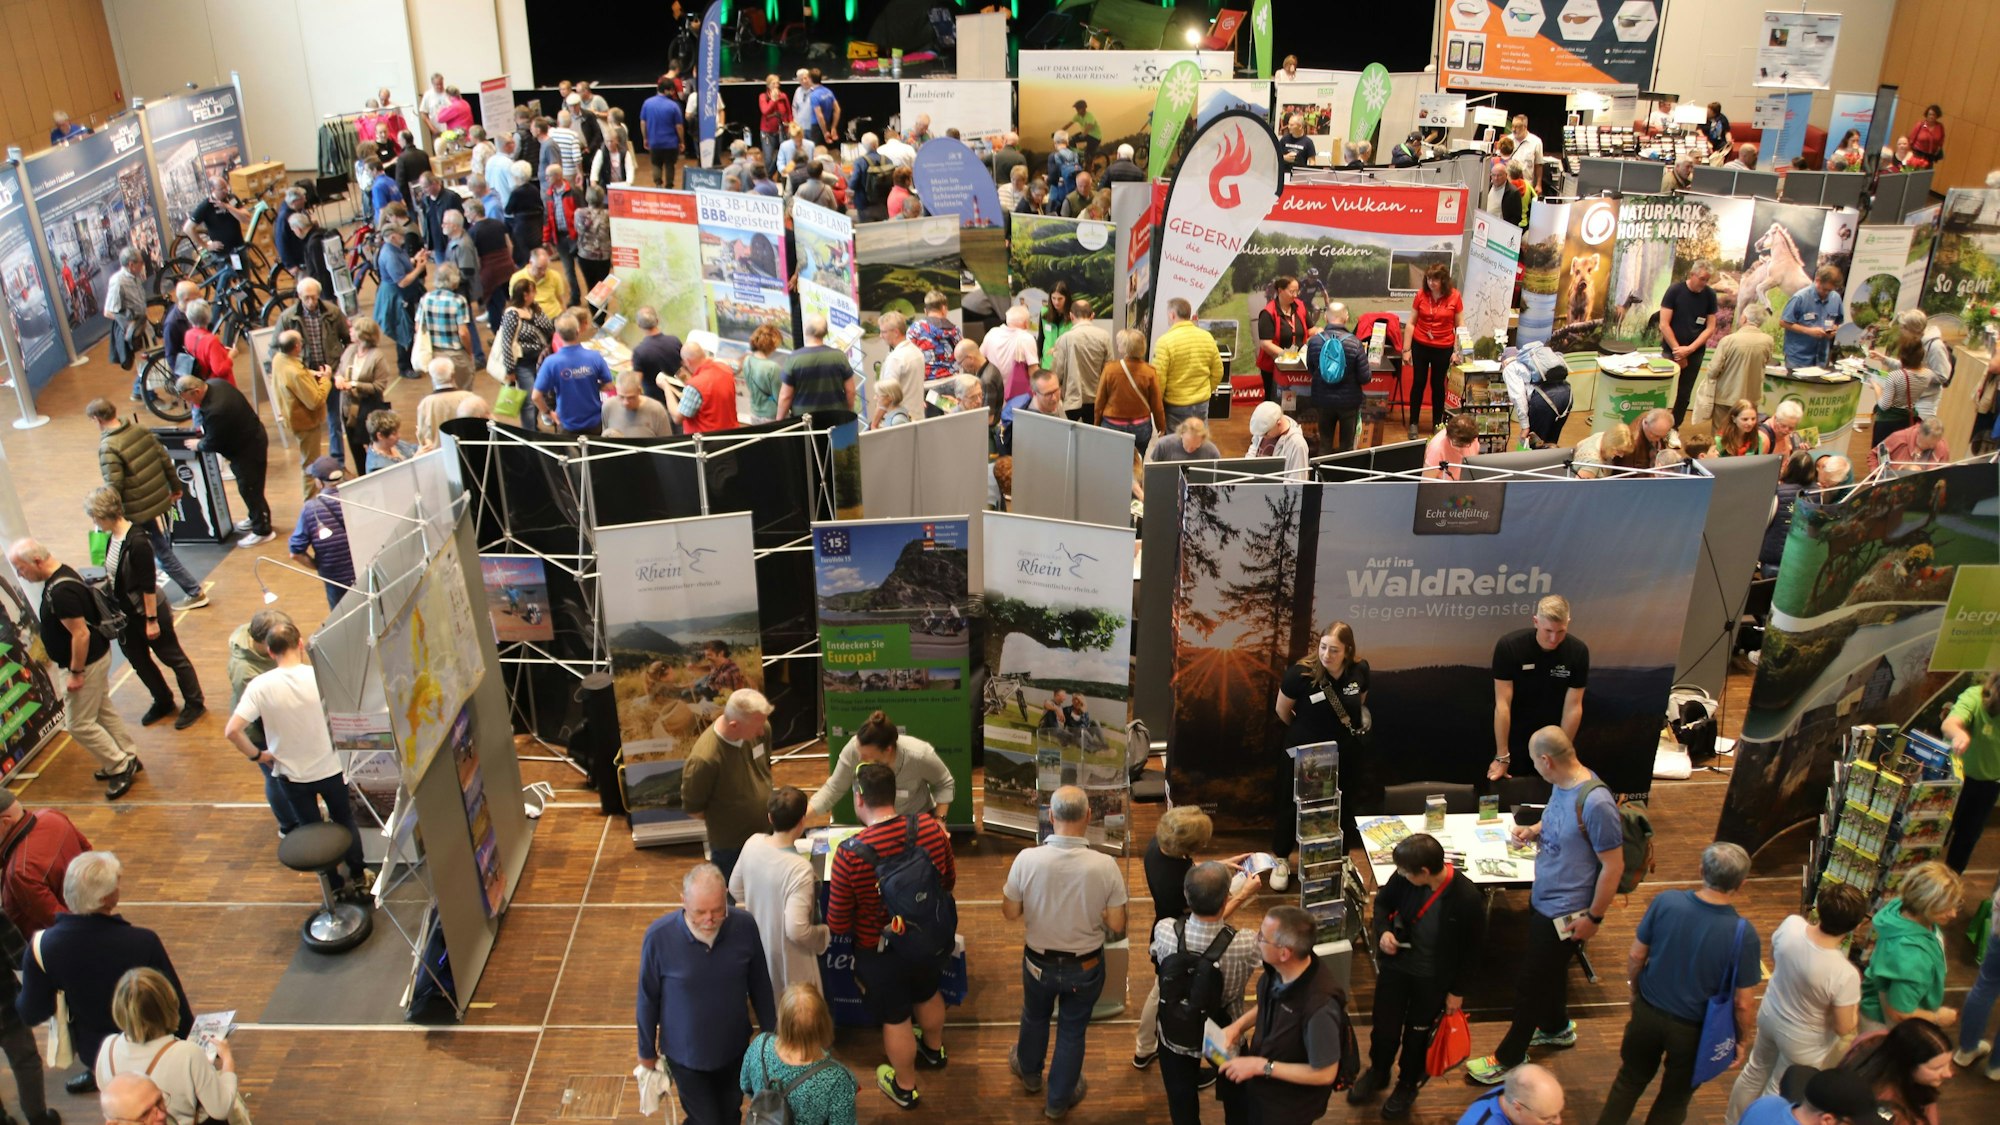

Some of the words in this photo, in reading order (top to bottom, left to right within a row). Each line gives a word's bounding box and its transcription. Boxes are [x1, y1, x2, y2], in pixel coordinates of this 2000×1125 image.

[904, 84, 955, 99] Tambiente
[193, 104, 224, 123] FELD
[701, 194, 721, 208] Das
[726, 196, 779, 215] 3B-LAND
[1283, 196, 1328, 211] dem
[1332, 196, 1407, 213] Vulkan
[1619, 203, 1703, 221] NATURPARK
[701, 207, 780, 230] BBBegeistert
[795, 205, 812, 219] Das
[814, 209, 850, 235] 3B-LAND
[1169, 217, 1242, 252] GEDERN
[1616, 222, 1653, 240] HOHE
[1657, 221, 1700, 239] MARK
[1186, 241, 1202, 254] die
[1319, 244, 1373, 257] Gedern
[1164, 250, 1220, 278] Vulkanstadt
[1173, 272, 1188, 283] am
[1190, 278, 1206, 290] See
[1934, 273, 1953, 293] So
[1956, 275, 1993, 297] geht
[1807, 407, 1829, 417] HOHE
[1426, 508, 1446, 519] Echt
[828, 538, 842, 549] 15
[1017, 558, 1062, 577] Rhein
[1365, 557, 1393, 568] Auf
[1393, 556, 1414, 568] ins
[635, 562, 682, 583] Rhein
[1346, 565, 1553, 598] WaldReich
[1349, 600, 1538, 622] Siegen-Wittgenstei
[826, 640, 870, 650] Entdecken
[871, 640, 885, 649] Sie
[827, 650, 877, 665] Europa!
